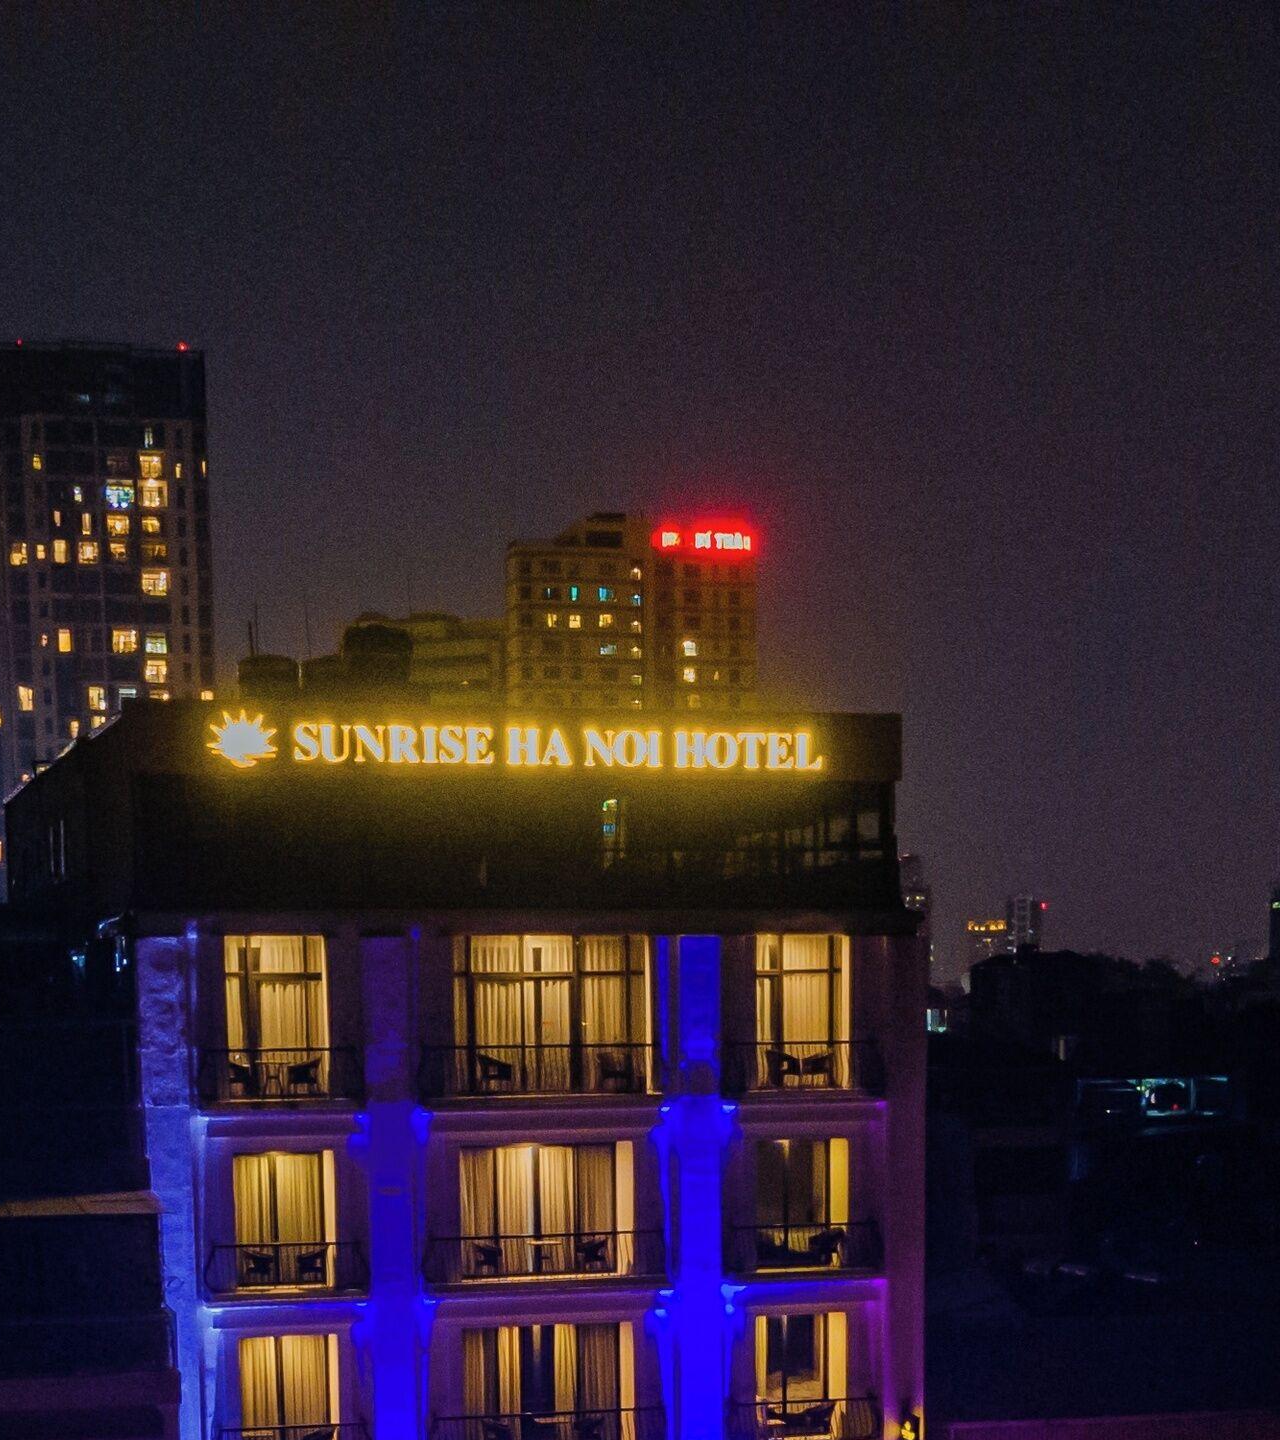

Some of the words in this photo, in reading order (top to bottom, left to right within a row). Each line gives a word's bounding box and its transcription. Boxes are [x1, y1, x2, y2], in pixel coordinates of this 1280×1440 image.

[293, 724, 495, 764] SUNRISE
[505, 727, 573, 766] HA
[583, 730, 663, 767] NOI
[673, 731, 822, 769] HOTEL
